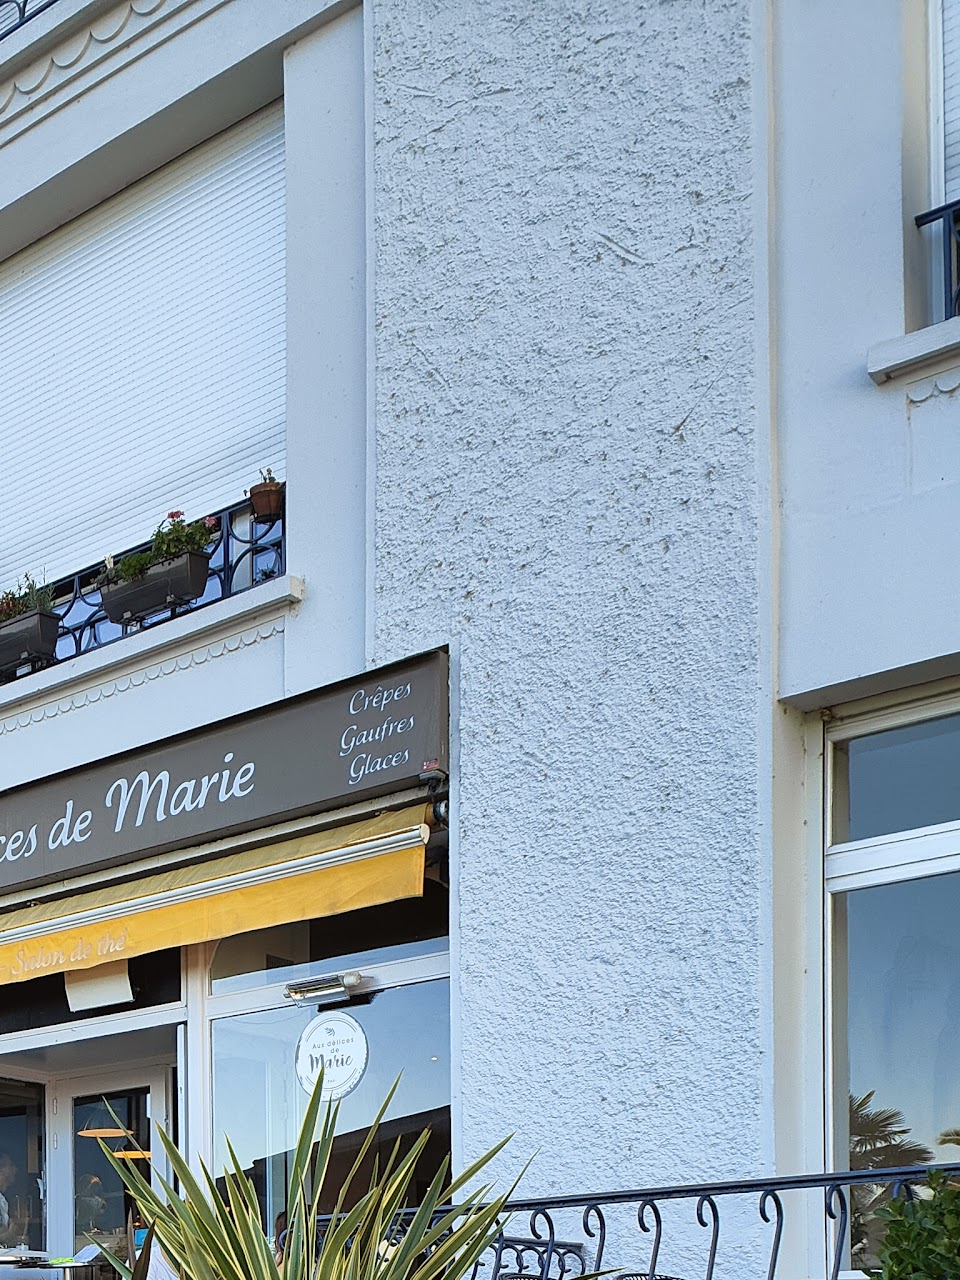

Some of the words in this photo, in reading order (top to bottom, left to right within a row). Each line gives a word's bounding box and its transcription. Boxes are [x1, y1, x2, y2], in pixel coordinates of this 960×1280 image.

[349, 681, 412, 715] Crêpes
[339, 715, 415, 757] Gaufres
[348, 748, 411, 785] Glaces
[47, 799, 93, 850] de
[105, 752, 257, 833] Marie
[11, 947, 67, 975] Salon
[70, 937, 92, 962] de
[97, 927, 129, 956] thé
[326, 1037, 354, 1047] délices
[308, 1053, 354, 1074] Marie
